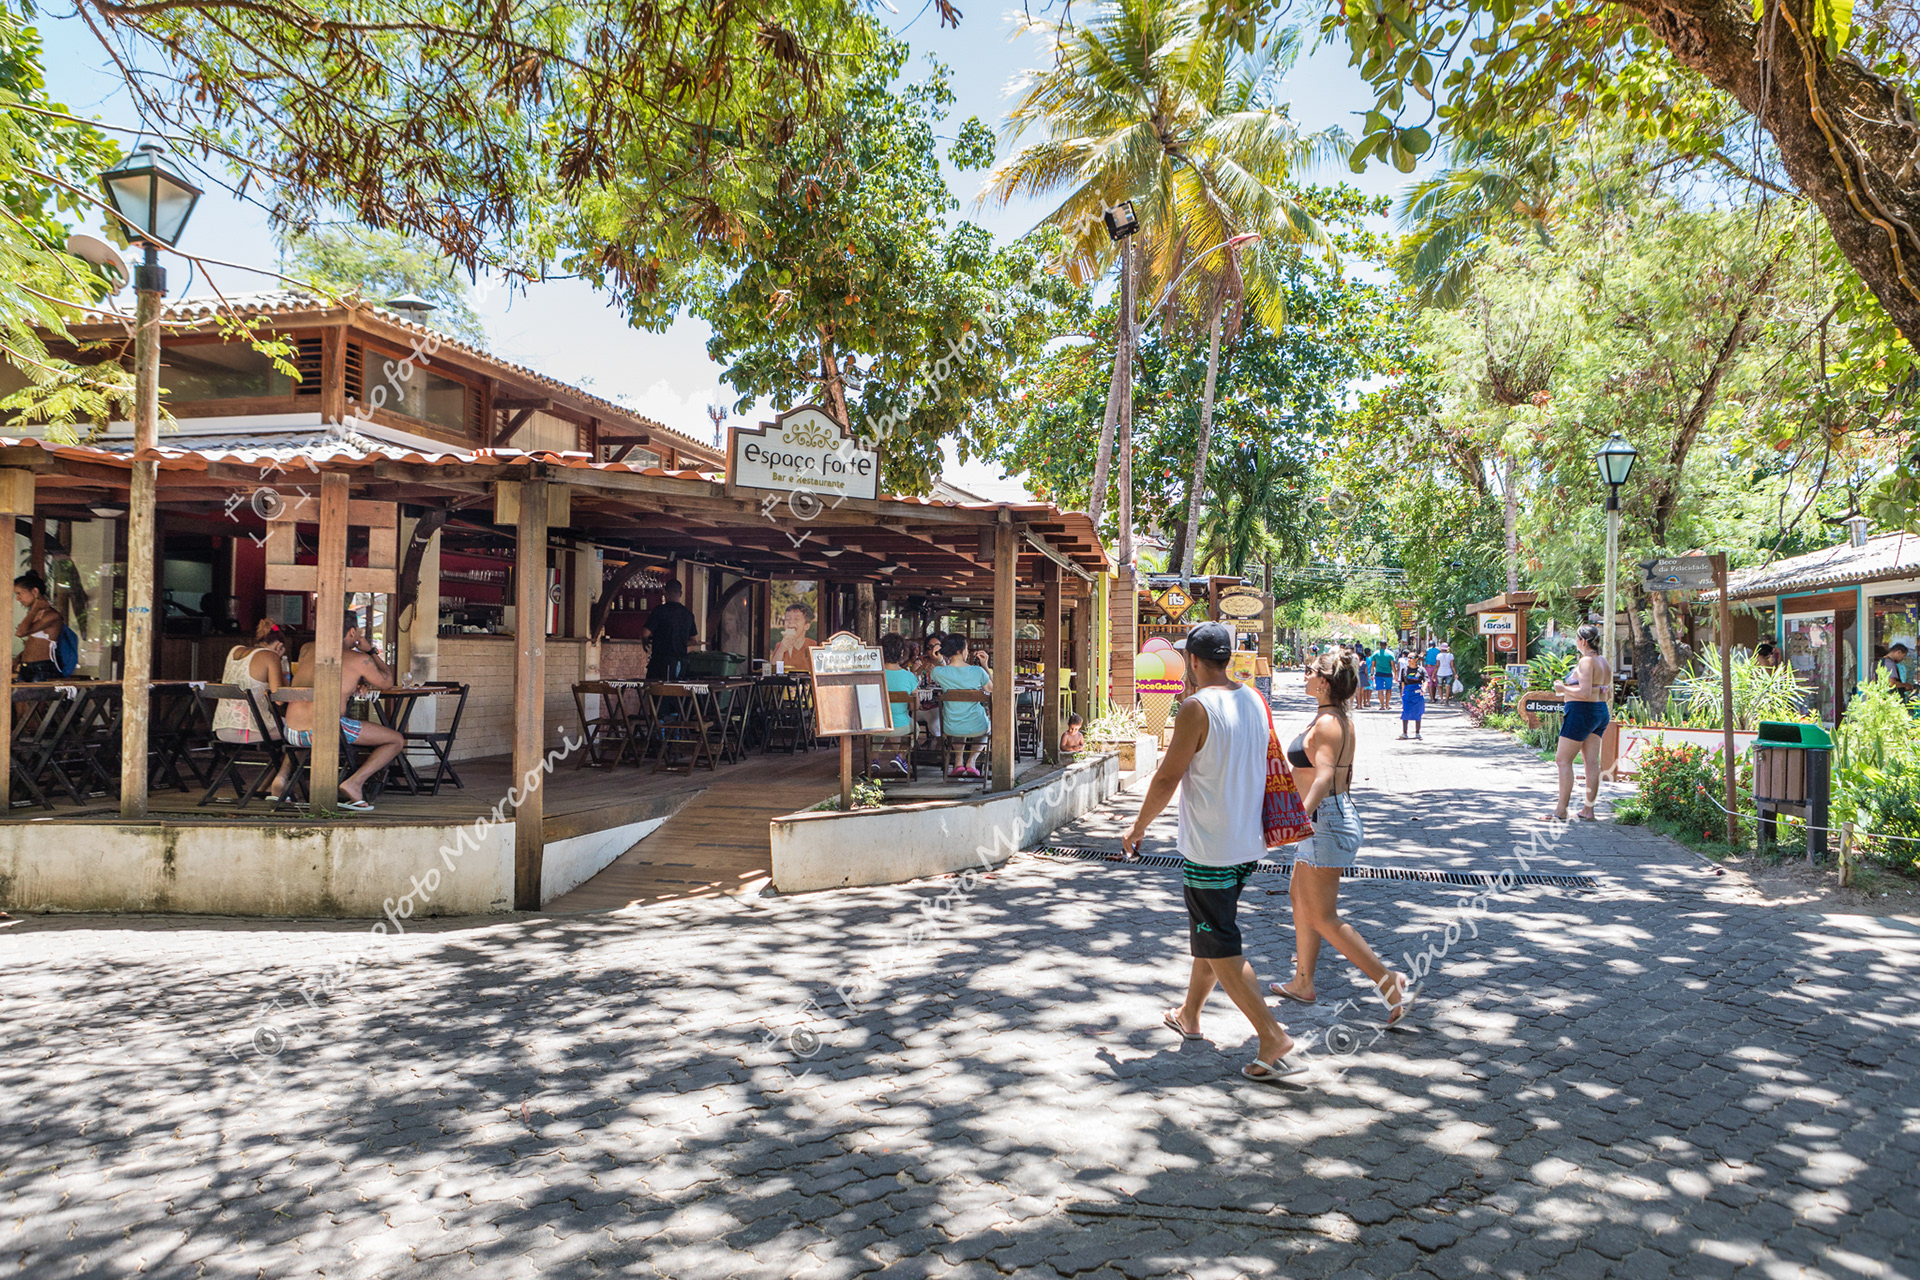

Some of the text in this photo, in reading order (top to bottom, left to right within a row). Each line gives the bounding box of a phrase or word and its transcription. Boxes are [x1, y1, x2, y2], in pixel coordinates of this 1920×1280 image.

[744, 443, 872, 476] espaço forte
[772, 471, 845, 489] Bar e Restaurante
[1670, 563, 1709, 572] Felicidade
[1698, 577, 1715, 585] VISA
[1526, 702, 1535, 710] all
